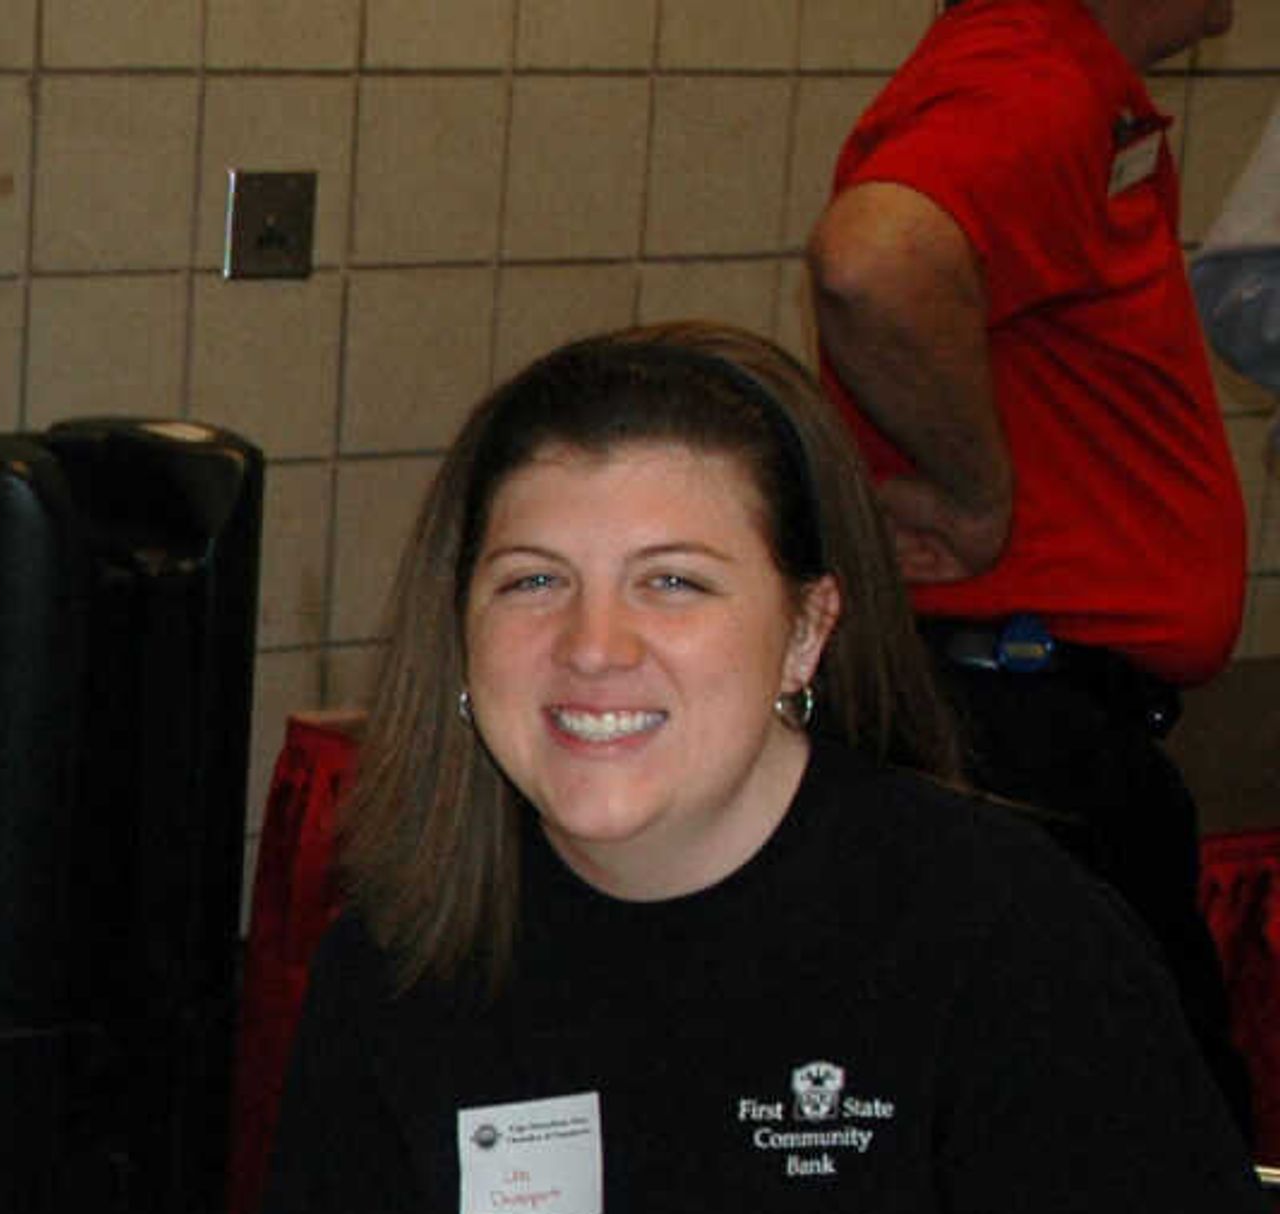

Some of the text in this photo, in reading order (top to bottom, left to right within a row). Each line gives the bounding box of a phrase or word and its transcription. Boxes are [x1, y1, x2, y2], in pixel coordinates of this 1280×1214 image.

[738, 1097, 895, 1121] First State
[752, 1126, 873, 1153] Community
[787, 1153, 837, 1176] Bank
